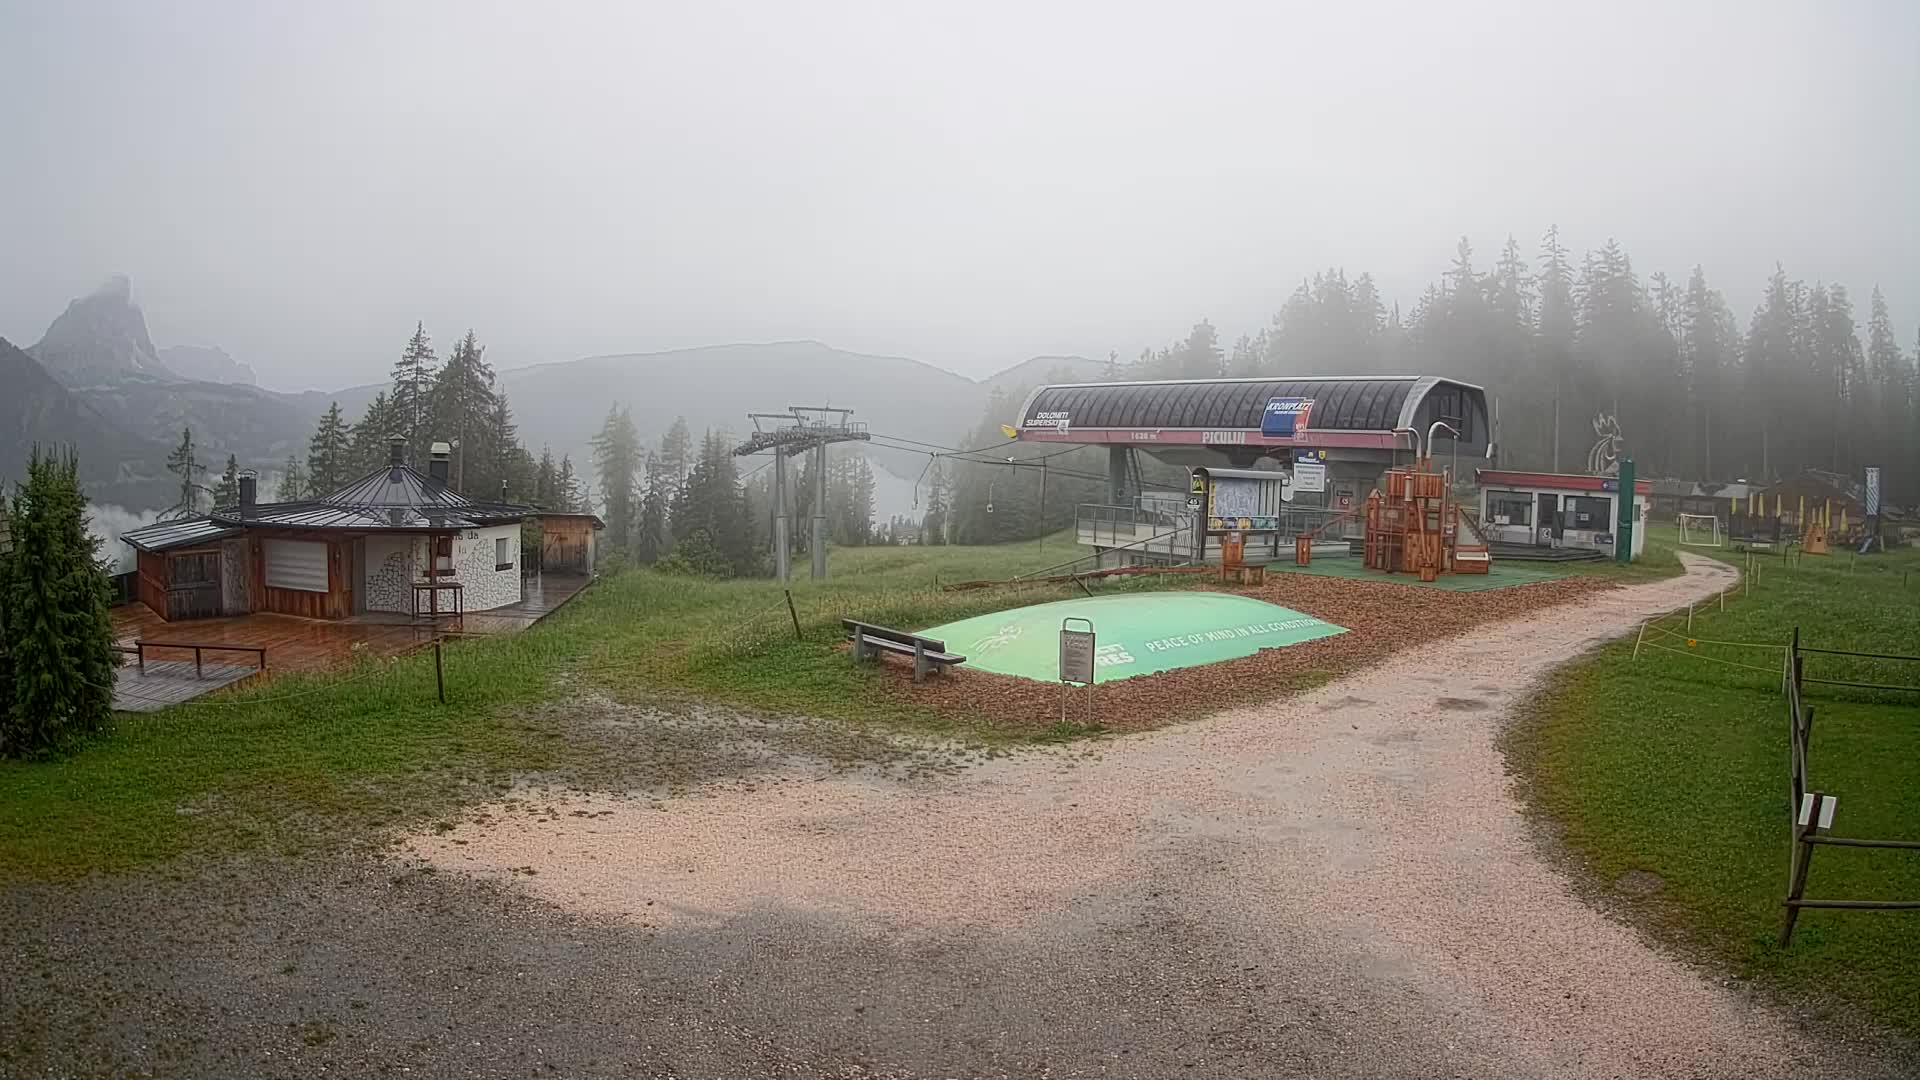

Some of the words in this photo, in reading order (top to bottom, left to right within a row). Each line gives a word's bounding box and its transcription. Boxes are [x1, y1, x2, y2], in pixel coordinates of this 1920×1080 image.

[1266, 402, 1314, 411] KRONPLATZ
[1037, 411, 1069, 419] DOLOMITI
[1025, 419, 1058, 427] SUPERSKI
[1202, 431, 1247, 444] PICULIN
[1145, 636, 1189, 652] PEACE
[1188, 632, 1206, 645] OF
[1204, 629, 1236, 643] MIND
[1234, 627, 1250, 638] IN
[1248, 623, 1270, 635] ALL
